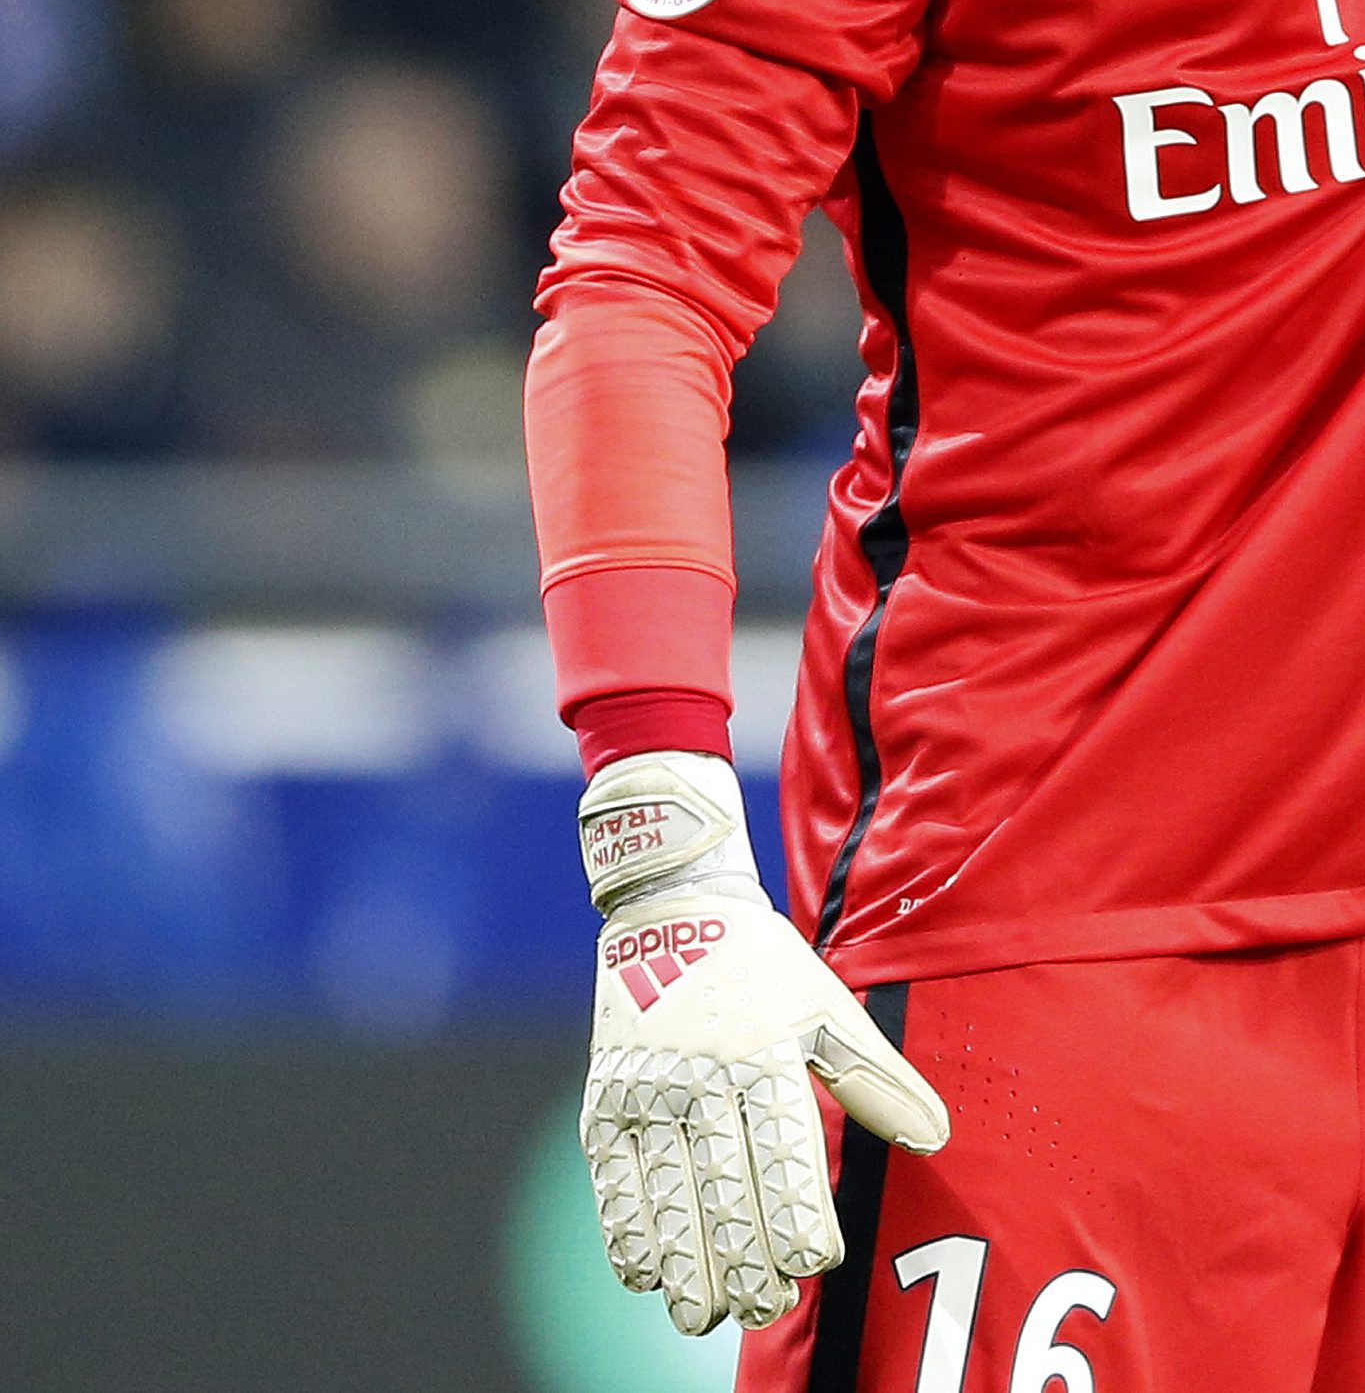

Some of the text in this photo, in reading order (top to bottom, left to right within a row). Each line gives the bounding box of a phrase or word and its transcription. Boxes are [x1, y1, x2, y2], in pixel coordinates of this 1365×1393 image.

[593, 828, 663, 870] KEVIN
[605, 918, 726, 969] adidas
[893, 1233, 1117, 1393] 16
